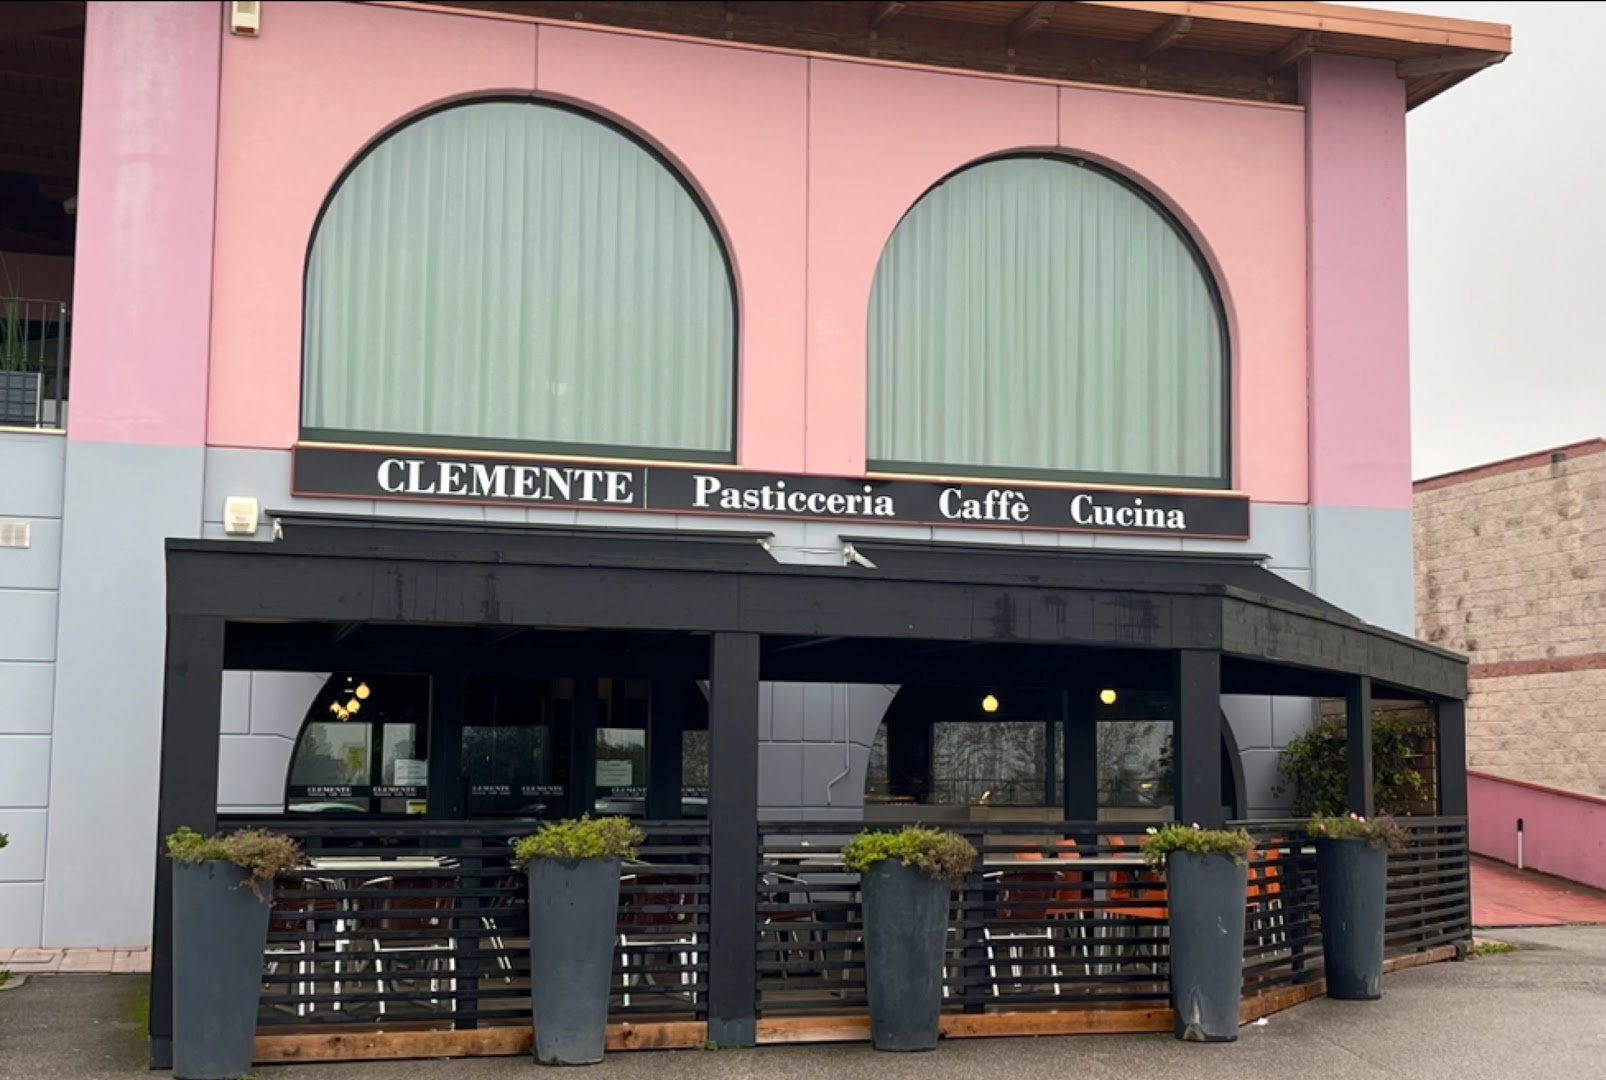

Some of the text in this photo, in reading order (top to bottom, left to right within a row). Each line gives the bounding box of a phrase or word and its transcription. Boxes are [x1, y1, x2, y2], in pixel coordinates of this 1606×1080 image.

[377, 458, 1186, 529] CLEMENTE Pasticceria Caffè Cucina
